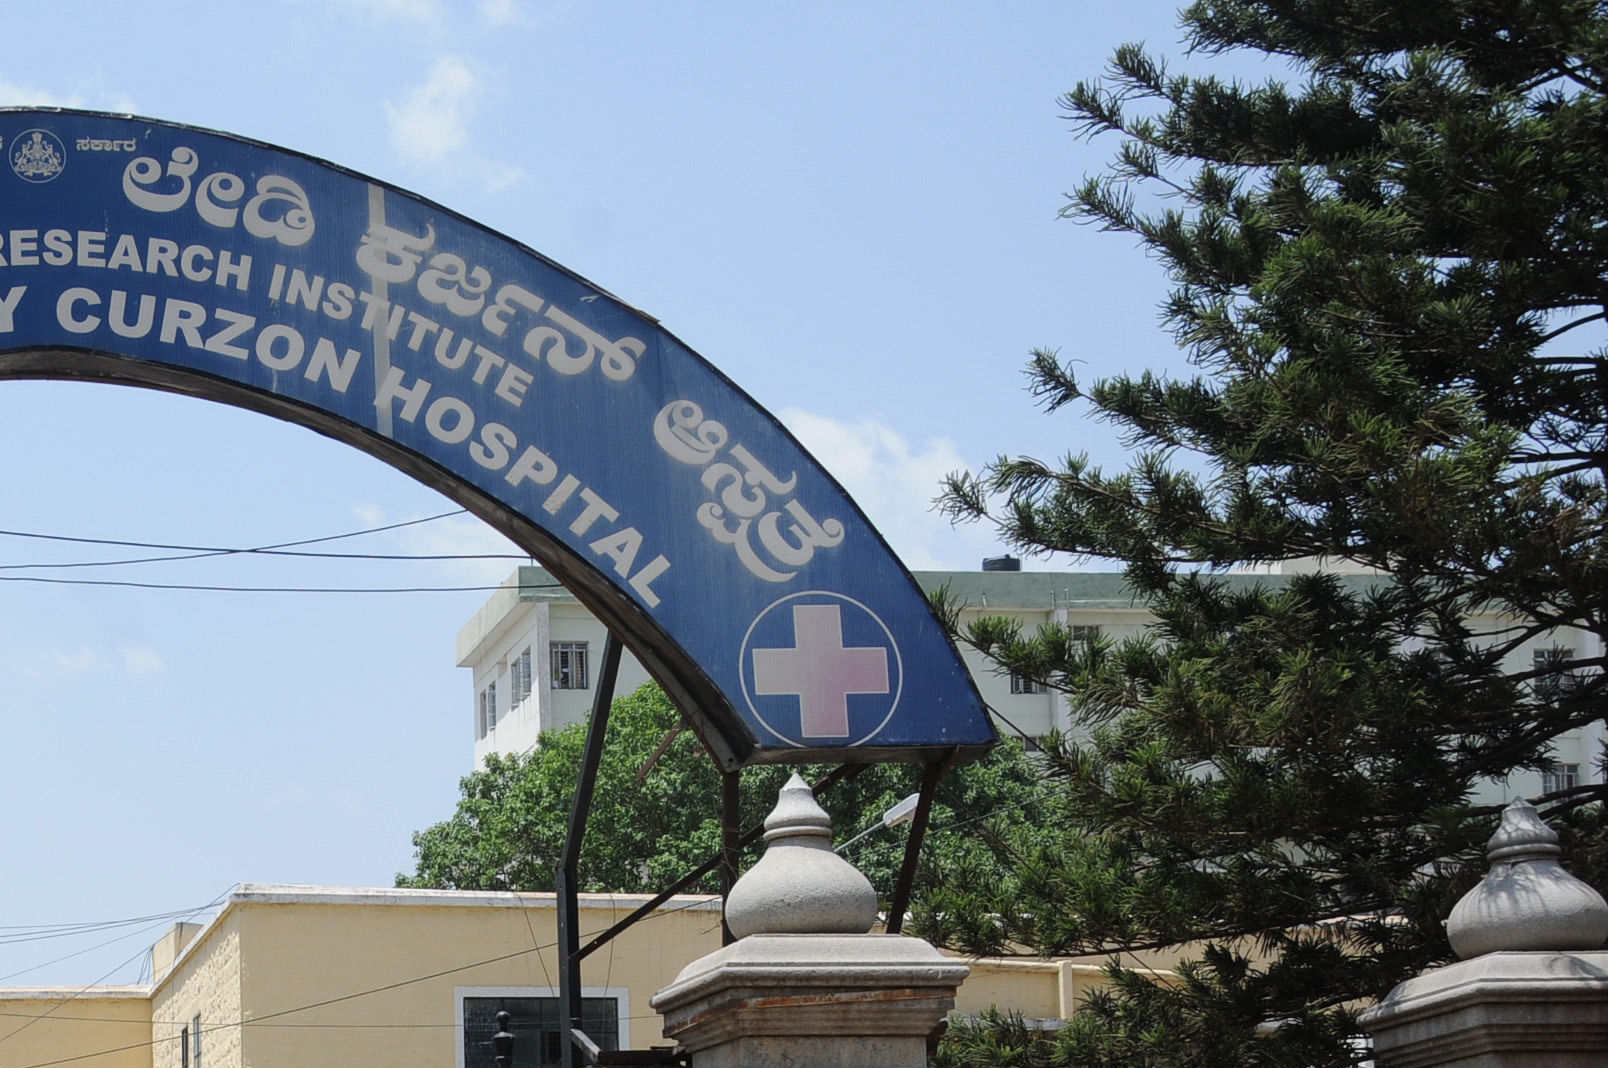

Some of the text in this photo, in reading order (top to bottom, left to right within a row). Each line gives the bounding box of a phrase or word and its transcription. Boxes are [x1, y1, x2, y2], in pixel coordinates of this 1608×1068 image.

[77, 138, 136, 151] ಸರ್ಕಾರ
[57, 288, 358, 393] CURZON
[377, 364, 671, 608] HOSPITAL
[123, 147, 315, 246] ಲೇಡಿ
[356, 221, 646, 382] ಕರ್ಜನ್
[653, 400, 844, 583] ಆಸ್ಪತ್ರೆ
[269, 264, 534, 407] INSTITUTE
